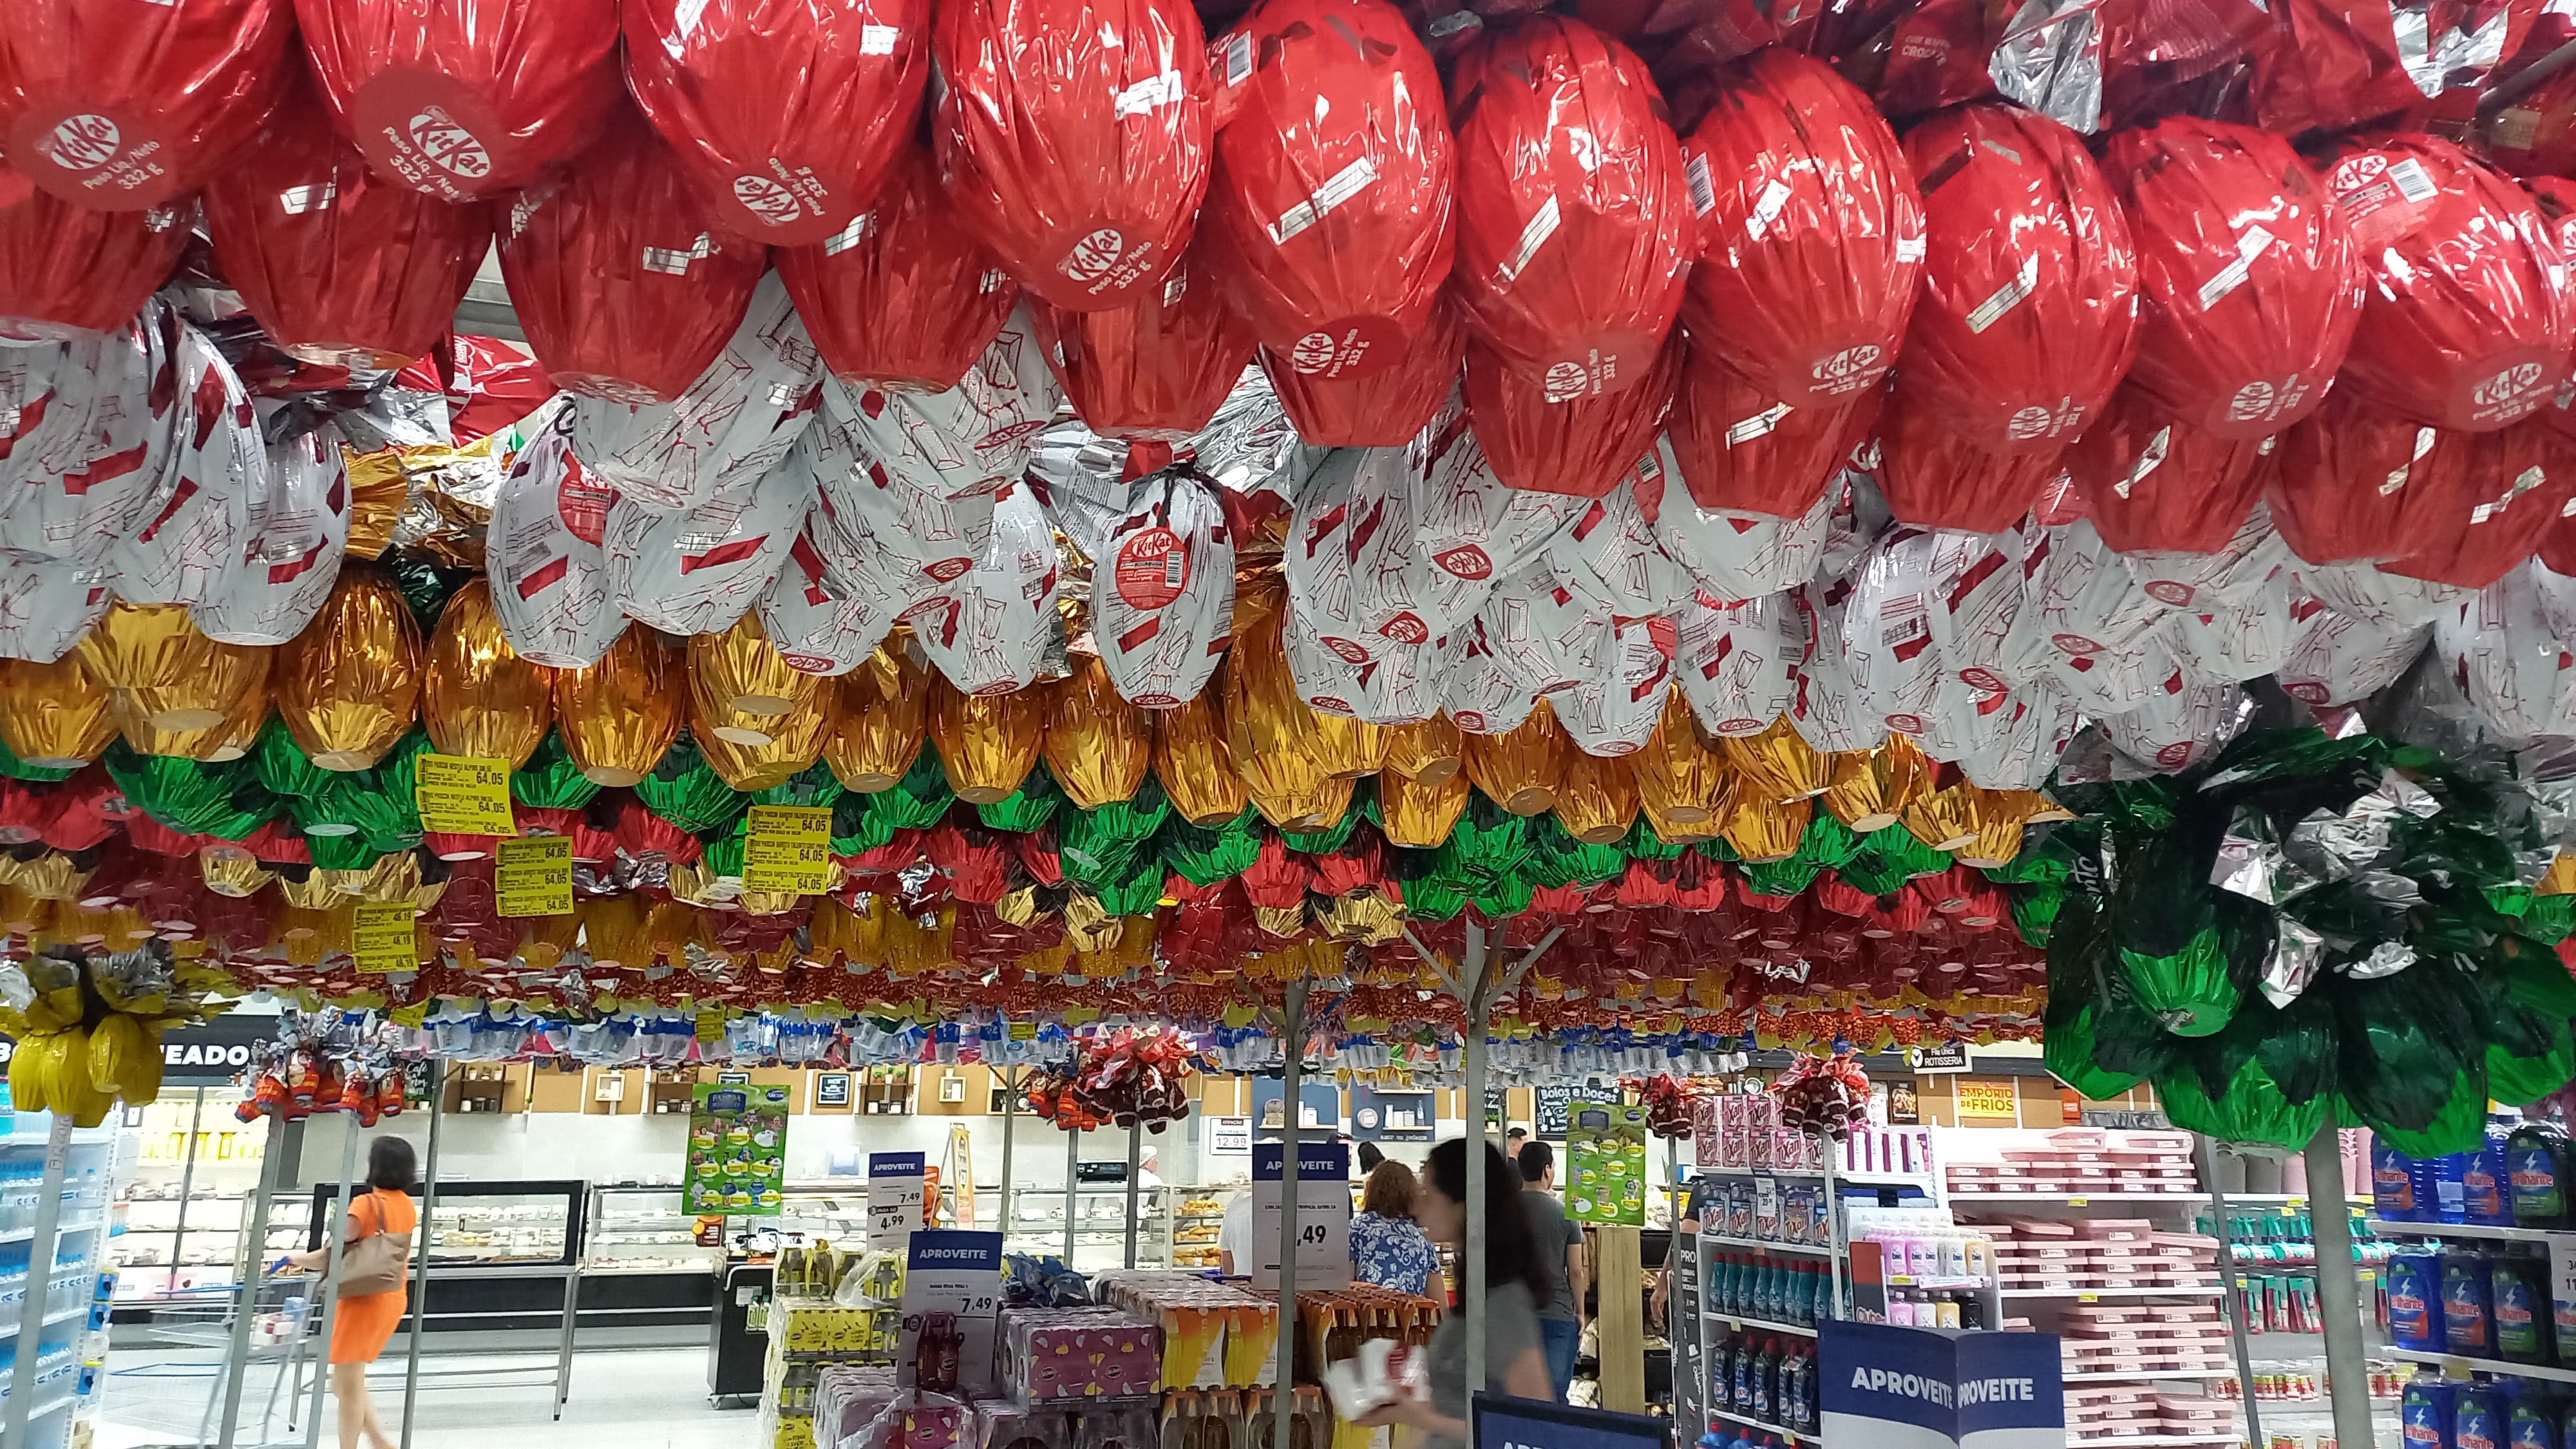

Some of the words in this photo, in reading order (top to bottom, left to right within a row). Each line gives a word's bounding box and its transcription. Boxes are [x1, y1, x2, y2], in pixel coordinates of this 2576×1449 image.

[54, 117, 118, 168] KitKat
[382, 126, 412, 154] Peso
[411, 118, 488, 175] KitKat
[118, 169, 151, 189] 332
[390, 155, 422, 183] 332
[802, 176, 828, 198] 332
[736, 178, 800, 218] KitKat
[1070, 230, 1119, 278] KitKat
[1088, 276, 1112, 295] Peso
[1108, 242, 1152, 277] Líq./Neto
[1114, 268, 1140, 289] 332
[1294, 334, 1334, 370] KitKat
[1346, 349, 1363, 366] 332
[1815, 346, 1879, 379] KitKat
[1547, 363, 1586, 396] KitKat
[2478, 364, 2541, 404] KitKat
[2233, 383, 2273, 417] KitKat
[1137, 533, 1171, 557] KitKat
[1448, 552, 1486, 574] KitKat
[1389, 620, 1421, 642] KitKat
[1331, 640, 1363, 660] KitKat
[476, 772, 503, 785] 64,05
[478, 802, 506, 813] 64,05
[484, 826, 511, 834] 64,05
[802, 819, 826, 833] 64,05
[545, 848, 567, 859] 64,05
[799, 849, 824, 862] 64,05
[545, 873, 567, 886] 64,05
[797, 878, 822, 891] 64,05
[546, 900, 569, 910] 64,05
[161, 1045, 249, 1065] EADO
[1924, 1056, 1964, 1066] ROTISSERIA
[1541, 1086, 1570, 1100] Bolos
[1572, 1088, 1580, 1097] e
[1582, 1086, 1618, 1103] Doces
[1972, 1099, 2014, 1112] FRIOS
[873, 1162, 915, 1171] APROVEITE
[1265, 1160, 1334, 1170] APVEITE
[900, 1193, 920, 1204] 7,49
[880, 1215, 904, 1231] 4,99
[1297, 1225, 1327, 1246] ,49
[919, 1249, 988, 1260] APROVEITE
[961, 1297, 992, 1313] 7,49
[1851, 1367, 1953, 1410] APROVEITE
[1957, 1378, 2034, 1409] PROVEITE
